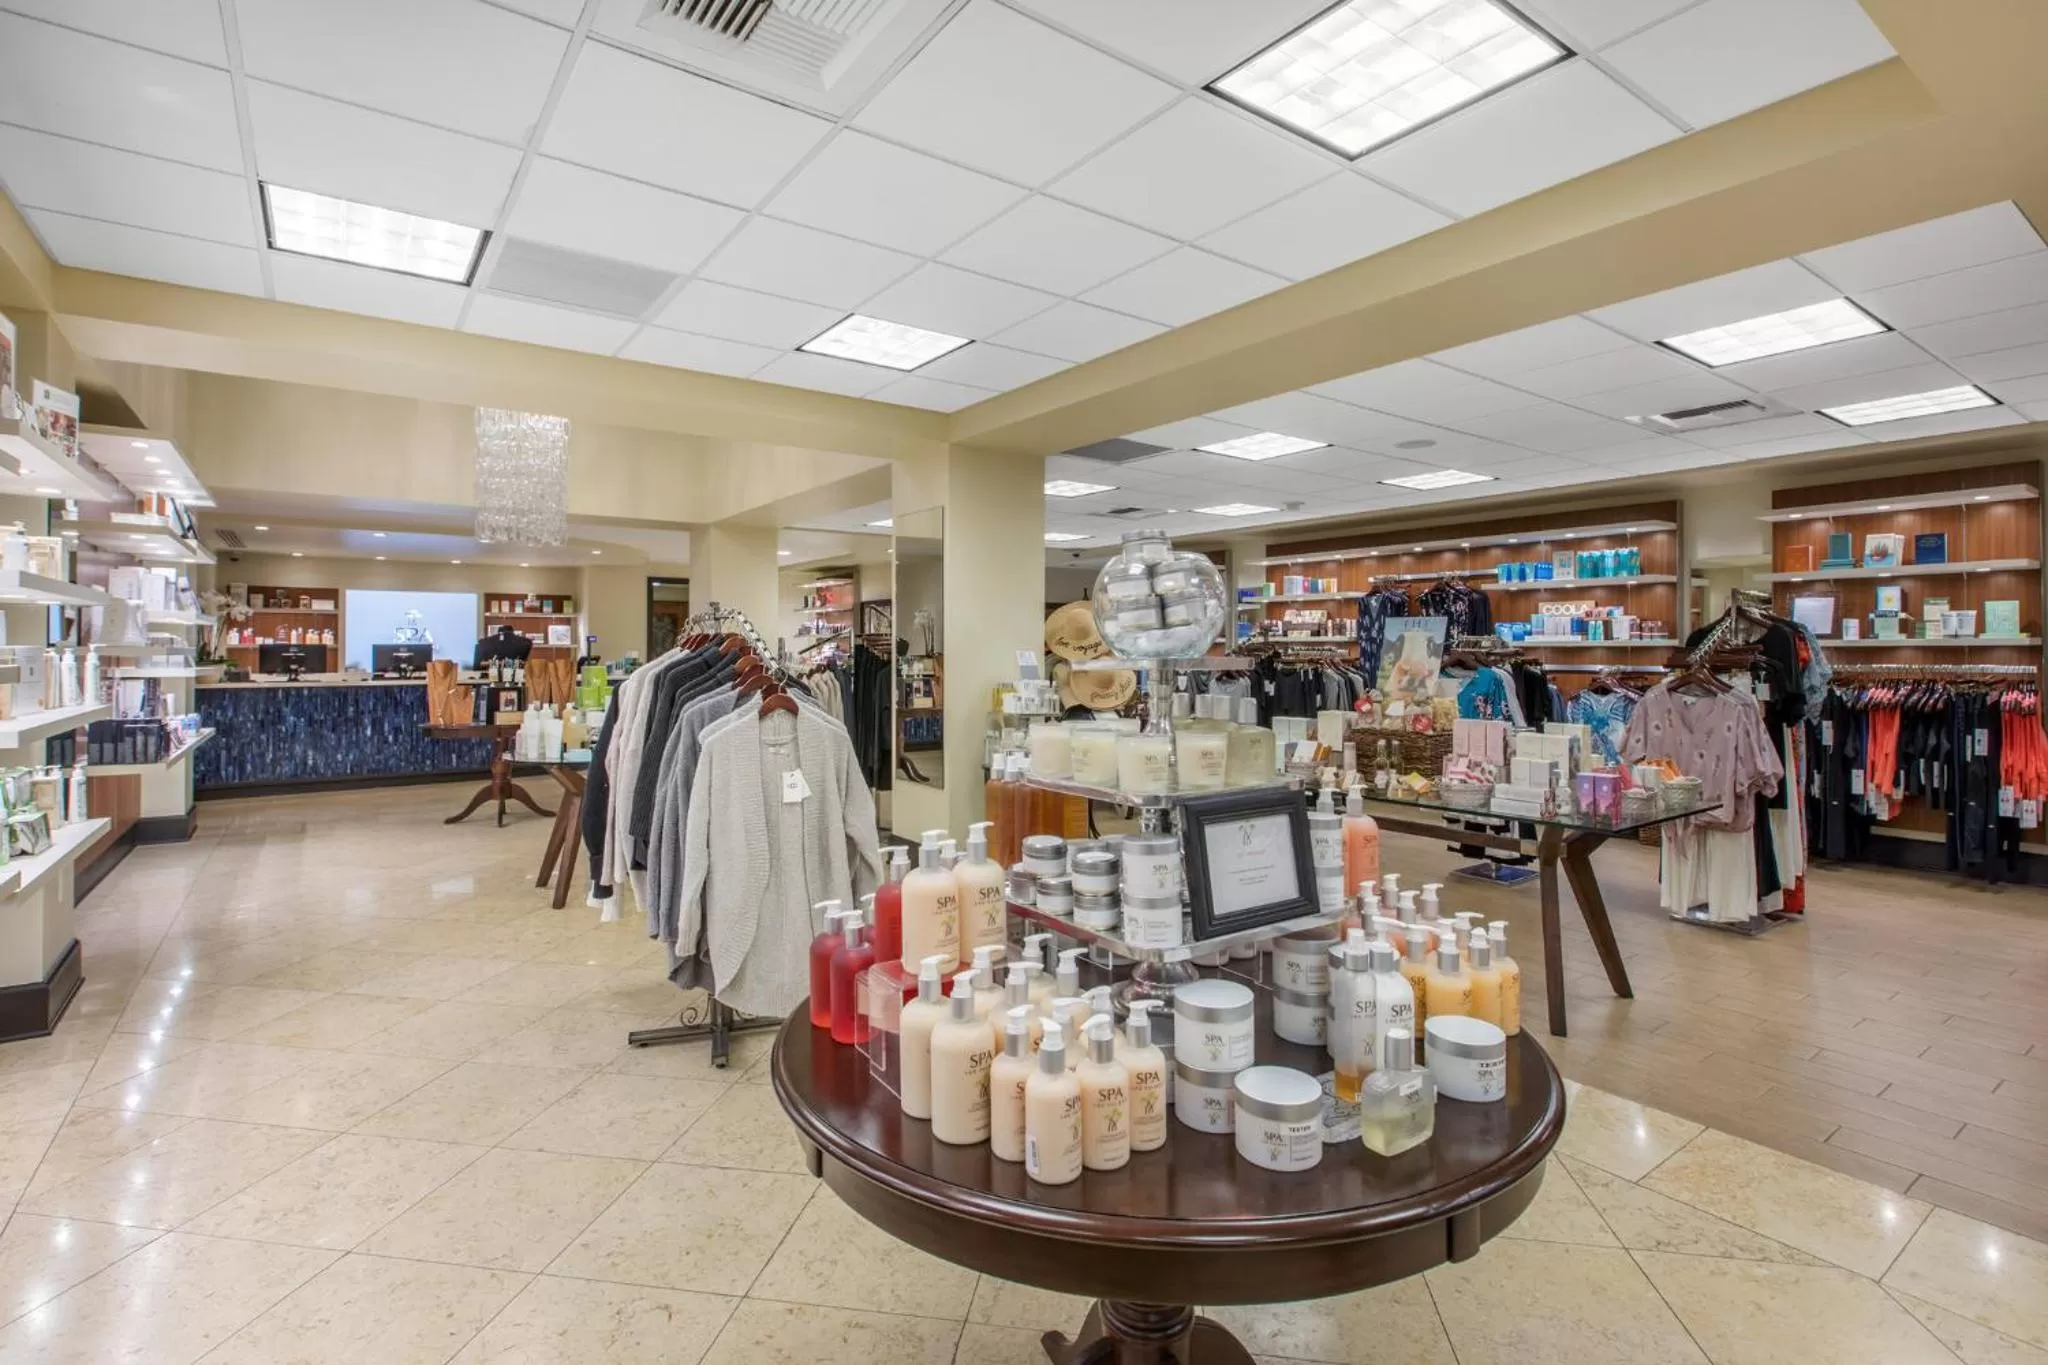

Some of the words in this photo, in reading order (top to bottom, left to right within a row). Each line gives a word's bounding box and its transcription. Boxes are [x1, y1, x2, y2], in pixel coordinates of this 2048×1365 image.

[1542, 603, 1588, 616] COOLA
[1152, 863, 1169, 873] SPA
[979, 886, 1001, 900] SPA
[936, 895, 957, 910] SPA
[1390, 1003, 1413, 1018] SPA
[1204, 1033, 1223, 1044] SPA
[969, 1049, 993, 1068] SPA
[1135, 1071, 1161, 1085] SPA
[1098, 1086, 1124, 1103] SPA
[1203, 1096, 1222, 1107] SPA
[1287, 1125, 1311, 1133] TESTER
[1264, 1130, 1284, 1143] SPA
